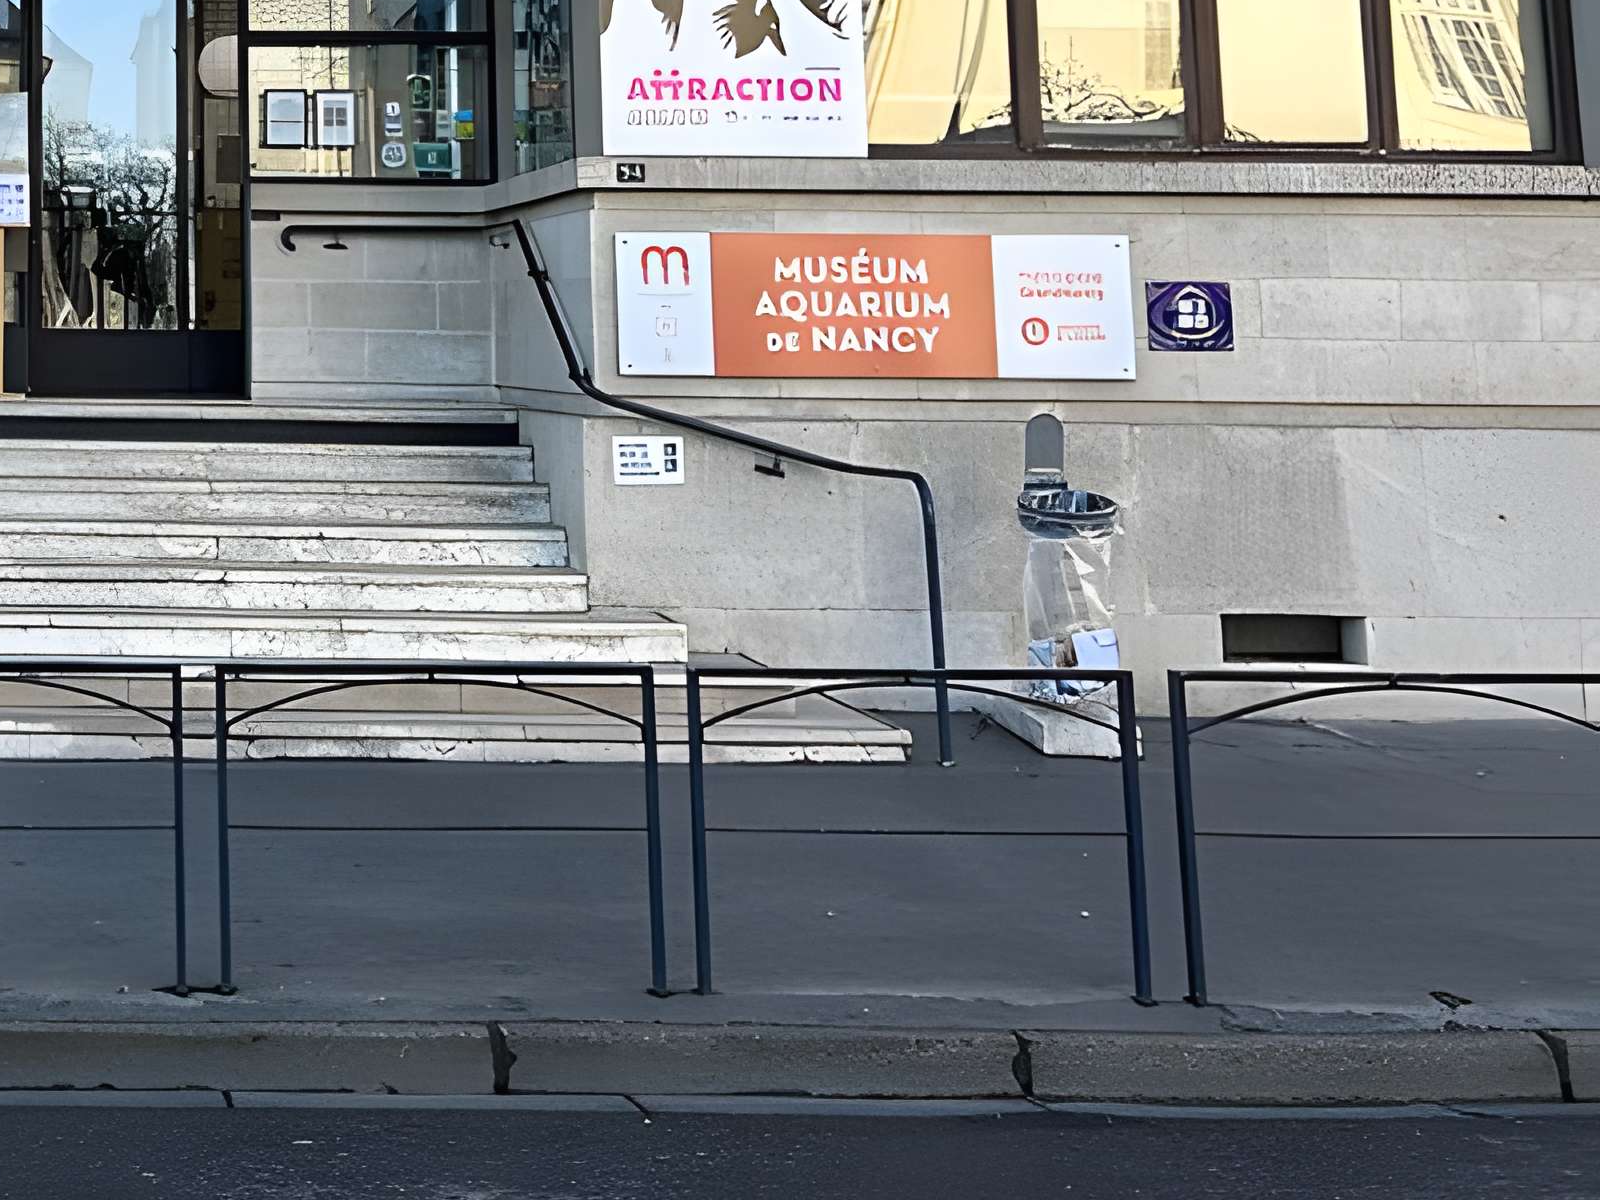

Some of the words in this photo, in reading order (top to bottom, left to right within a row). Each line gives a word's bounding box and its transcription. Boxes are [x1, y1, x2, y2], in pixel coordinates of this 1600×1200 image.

[774, 247, 929, 285] MUSÉUM
[754, 289, 951, 323] AQUARIUM
[811, 325, 940, 354] NANCY
